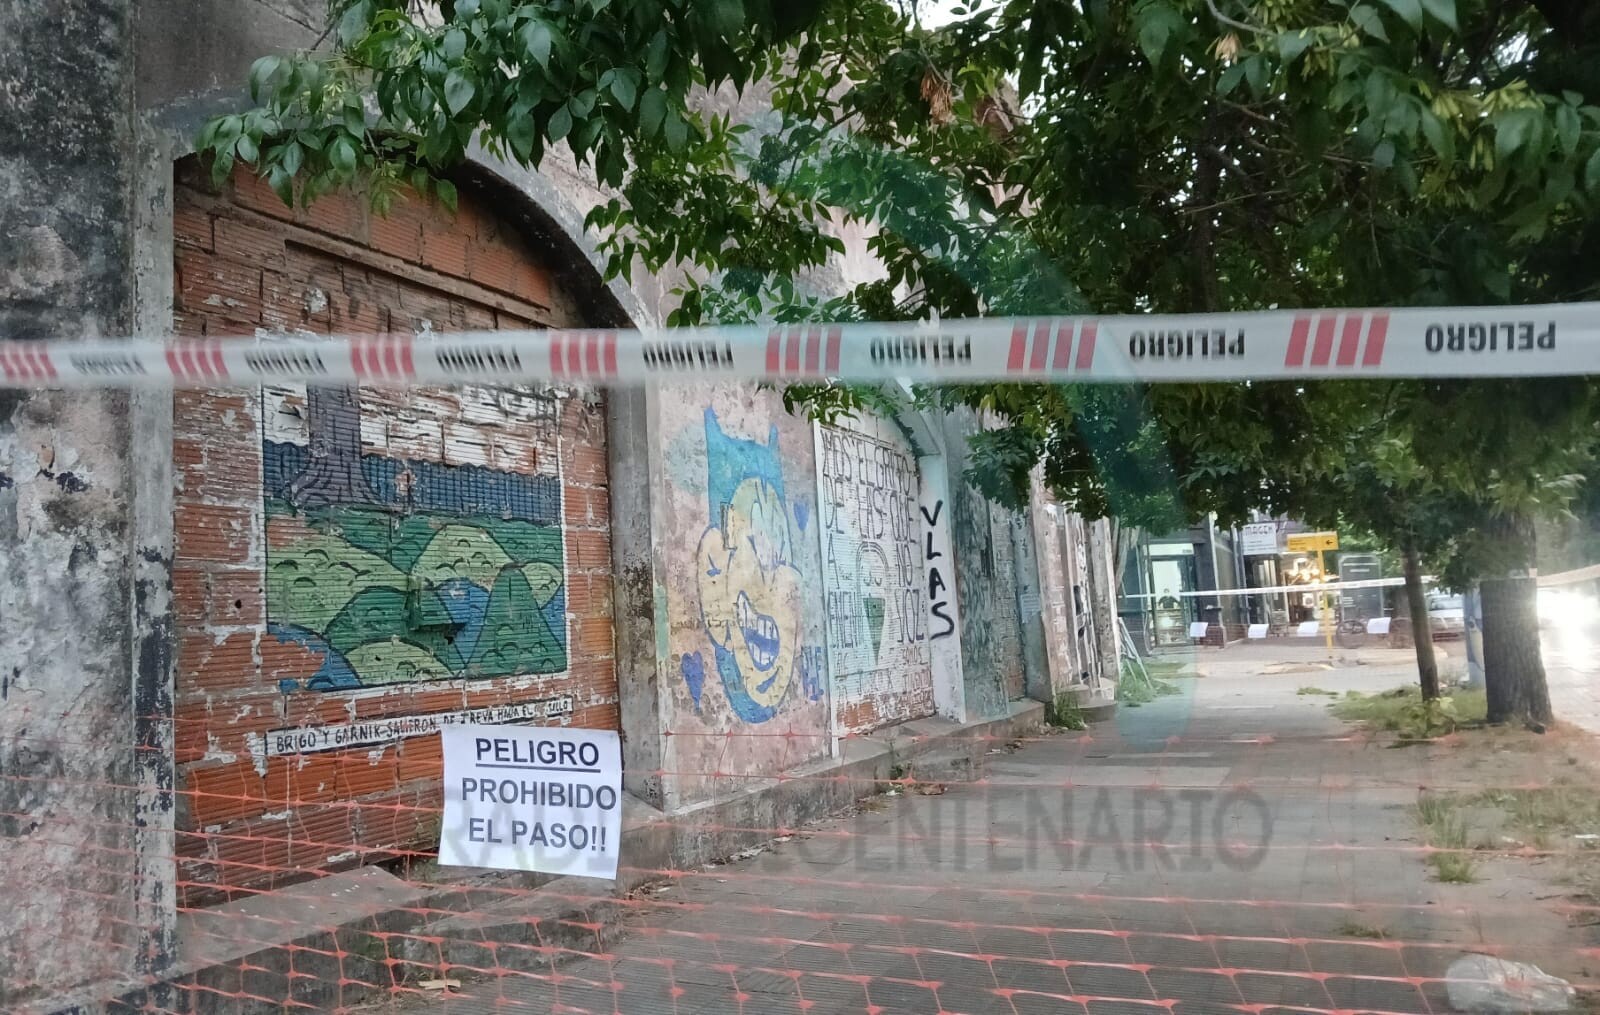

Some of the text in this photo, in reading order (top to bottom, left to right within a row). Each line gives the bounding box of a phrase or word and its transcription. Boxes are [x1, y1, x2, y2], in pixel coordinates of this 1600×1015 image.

[1129, 328, 1245, 361] PELIGRO
[1425, 321, 1556, 353] PELIGRO
[276, 731, 317, 753] BRIGO
[475, 737, 600, 767] PELIGRO
[462, 777, 617, 811] PROHIBIDO
[469, 817, 606, 852] EL PASO!!
